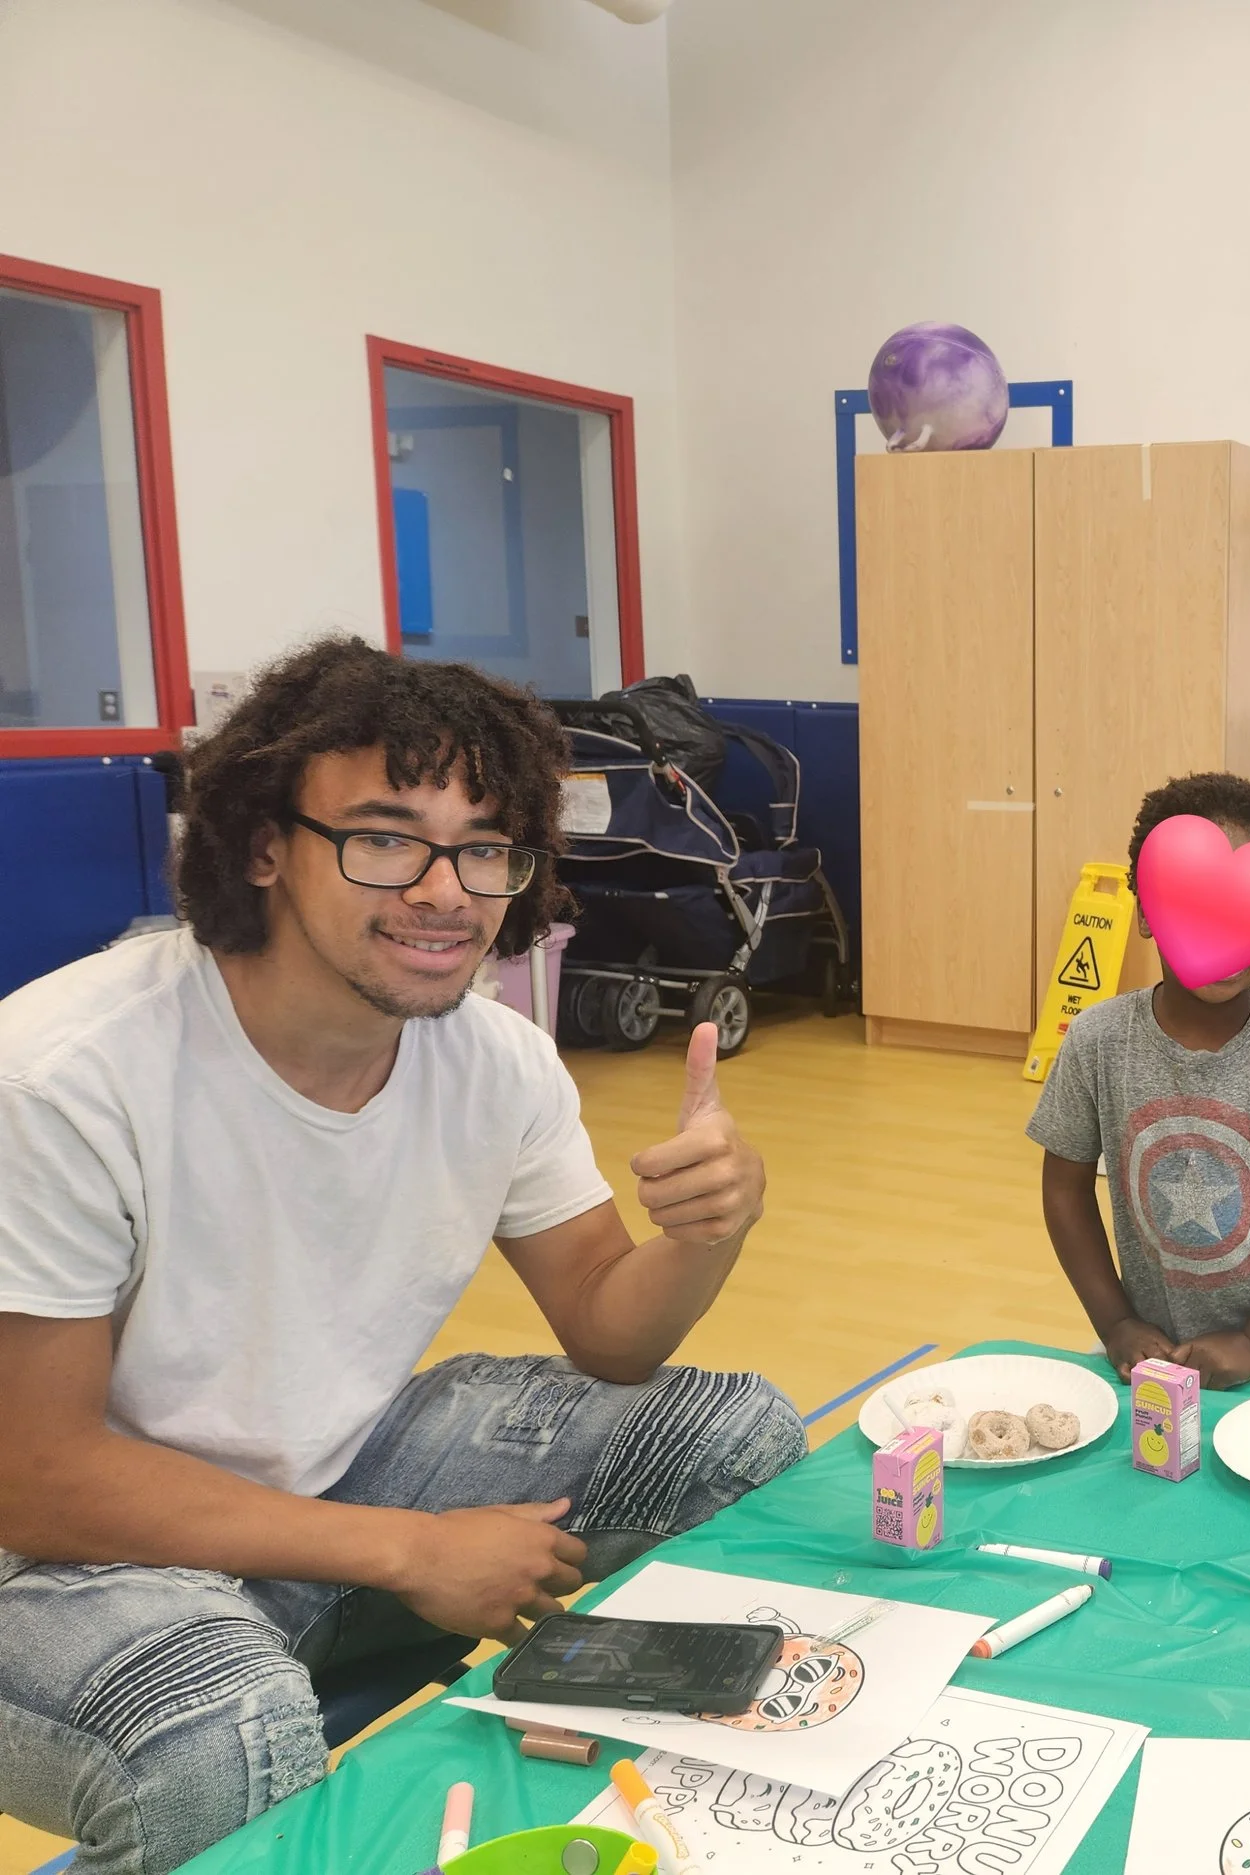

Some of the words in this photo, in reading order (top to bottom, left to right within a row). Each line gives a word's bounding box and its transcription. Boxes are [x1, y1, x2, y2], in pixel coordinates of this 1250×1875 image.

[1073, 913, 1113, 930] CAUTION
[1068, 995, 1082, 1004] WET
[1135, 1399, 1172, 1416] SUNCUP
[876, 1495, 903, 1508] JUICE
